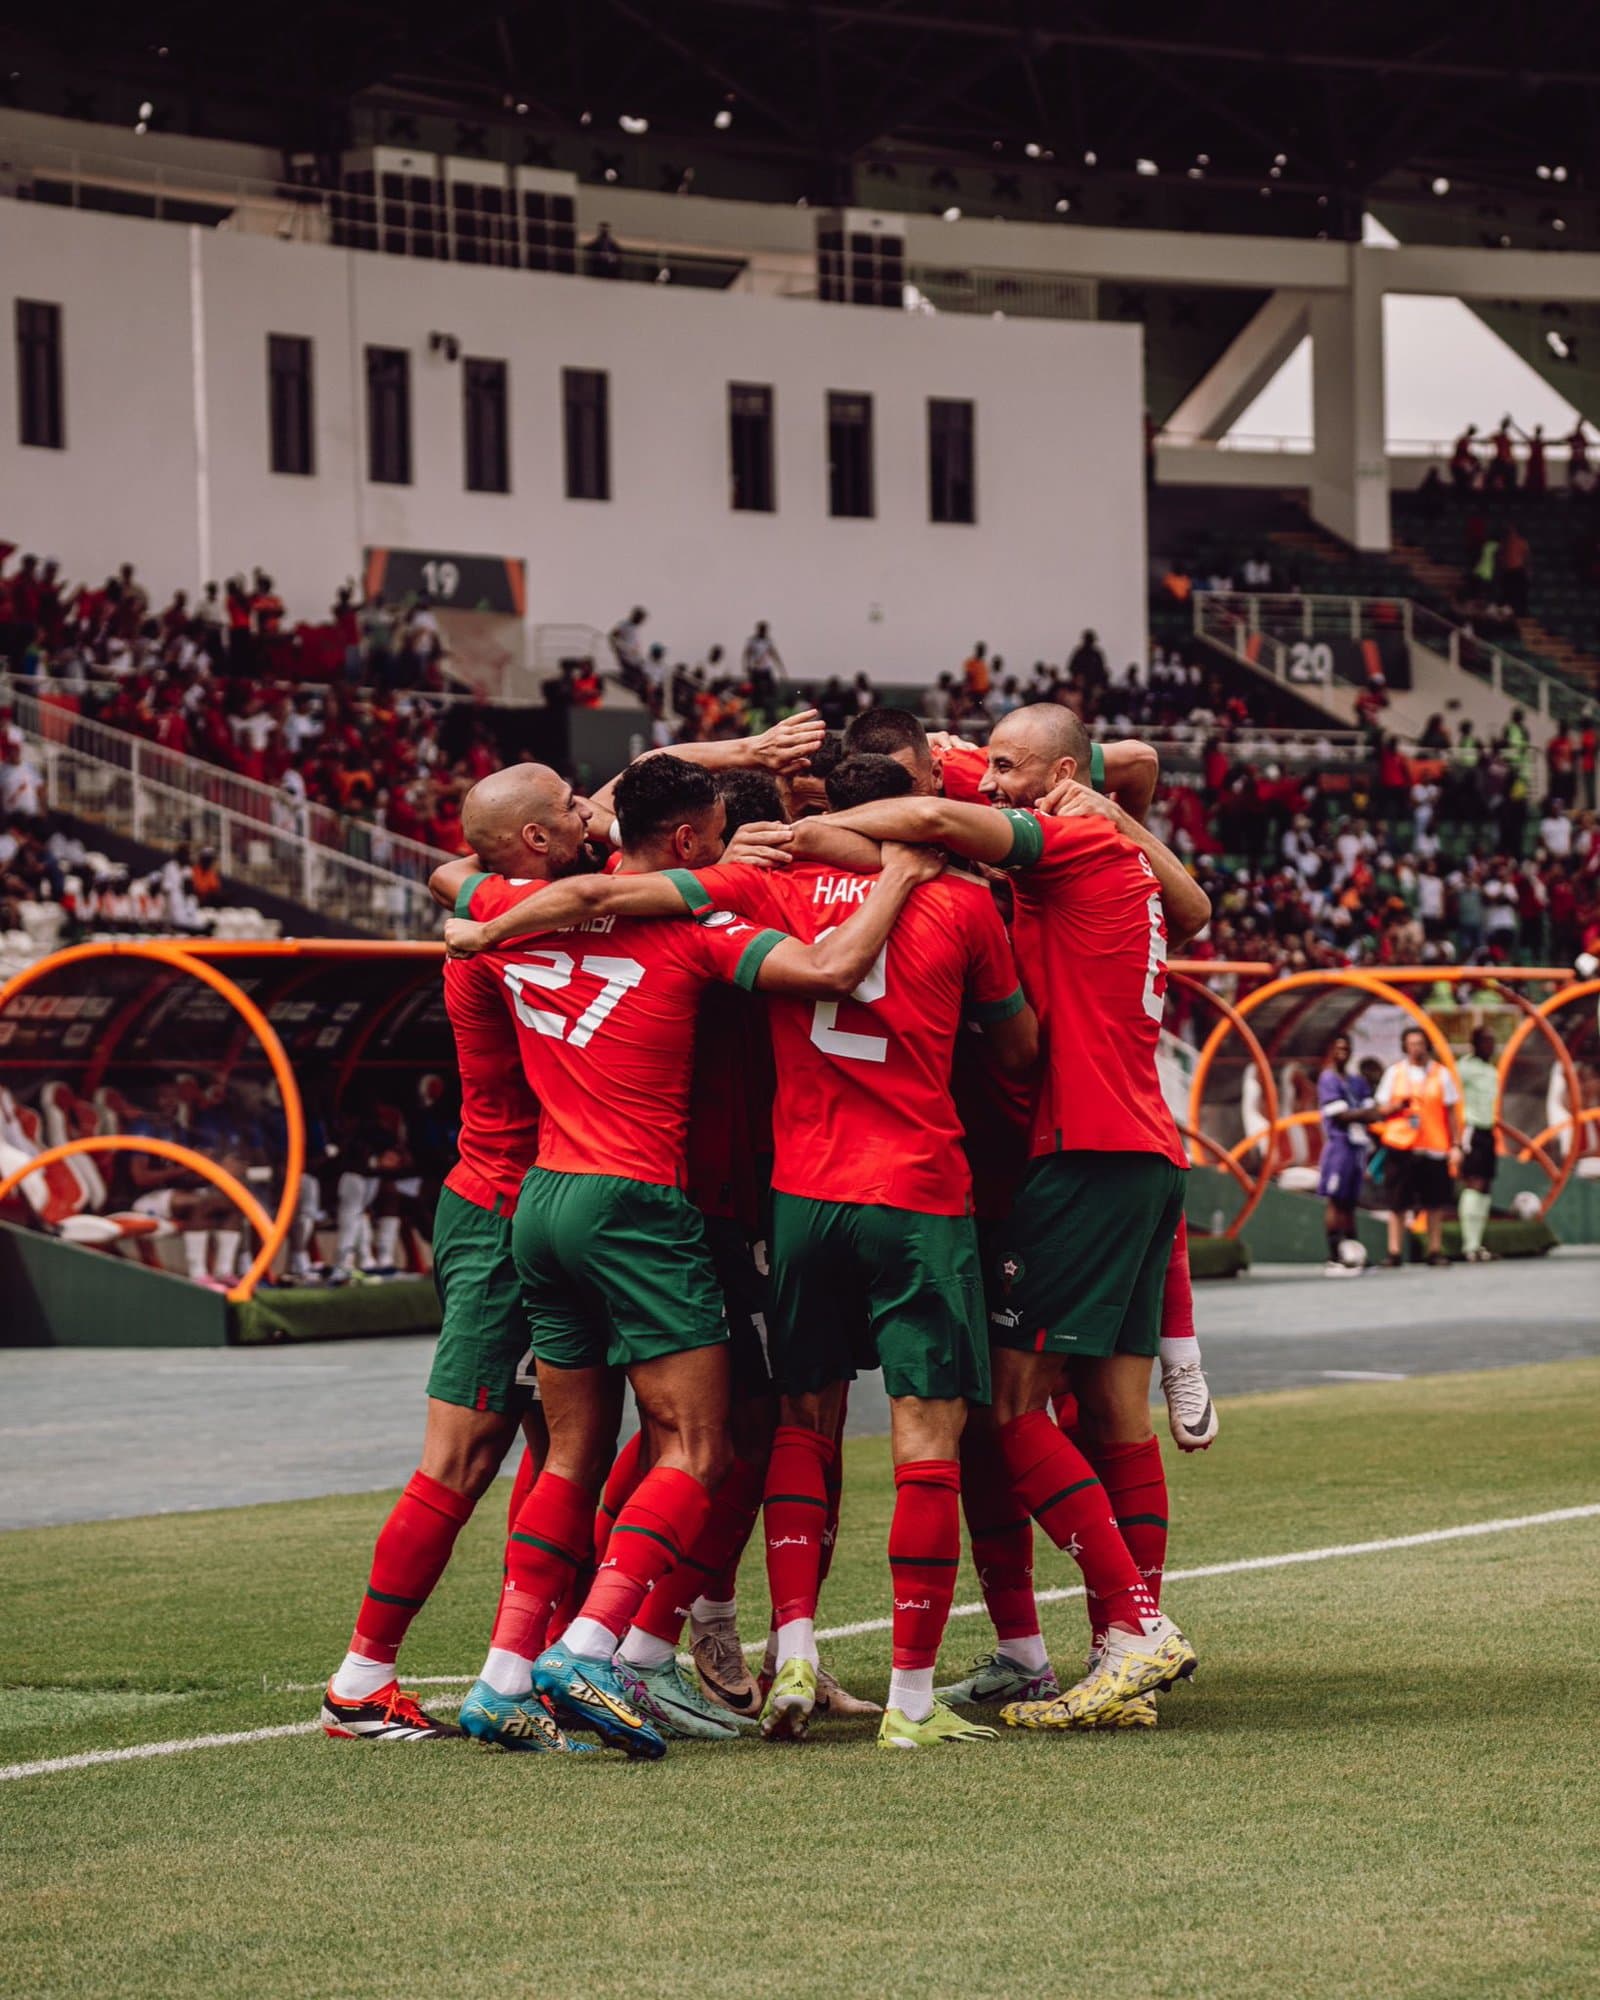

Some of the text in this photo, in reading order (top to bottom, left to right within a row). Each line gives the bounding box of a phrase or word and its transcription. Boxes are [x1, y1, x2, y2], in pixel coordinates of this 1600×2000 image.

[422, 560, 459, 598] 19
[1290, 642, 1333, 681] 20
[503, 950, 646, 1048] 27
